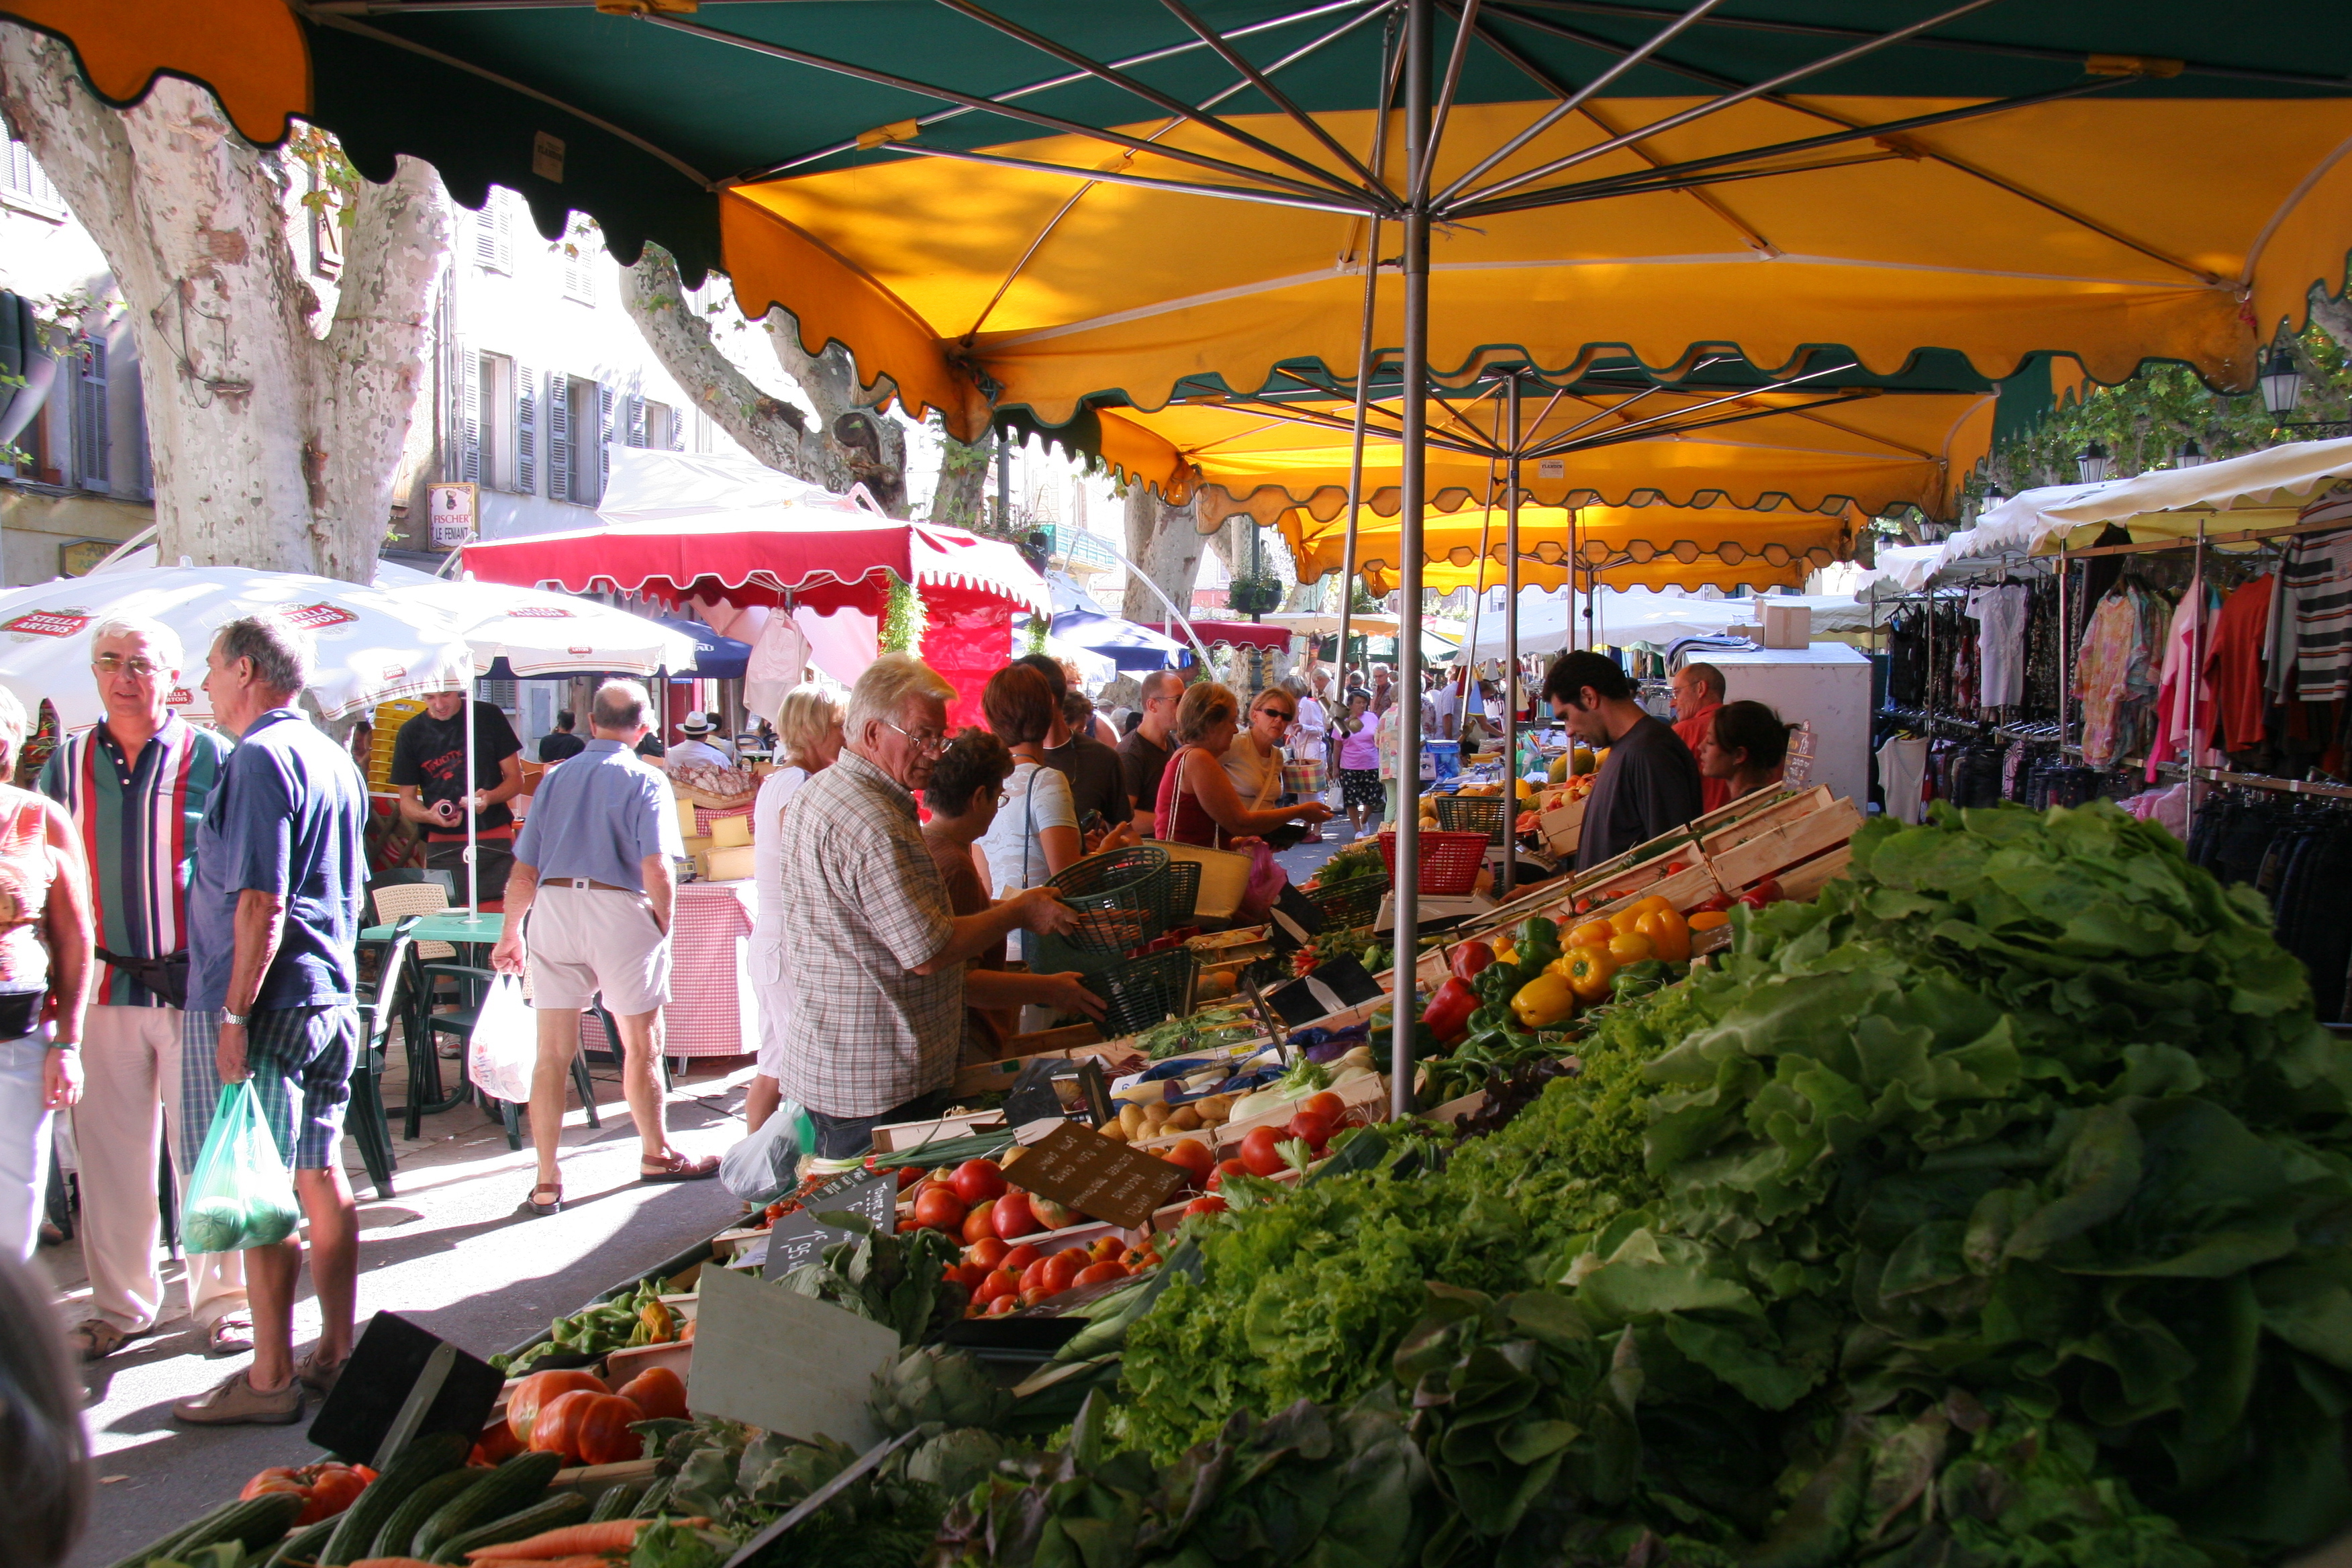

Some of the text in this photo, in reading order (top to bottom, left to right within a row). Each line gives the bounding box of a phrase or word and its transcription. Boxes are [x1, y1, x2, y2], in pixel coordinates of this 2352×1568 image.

[434, 514, 469, 524] FISCHER
[436, 527, 469, 540] LE FENIANT
[28, 614, 83, 626] STELLA
[13, 622, 73, 633] ARTOIS
